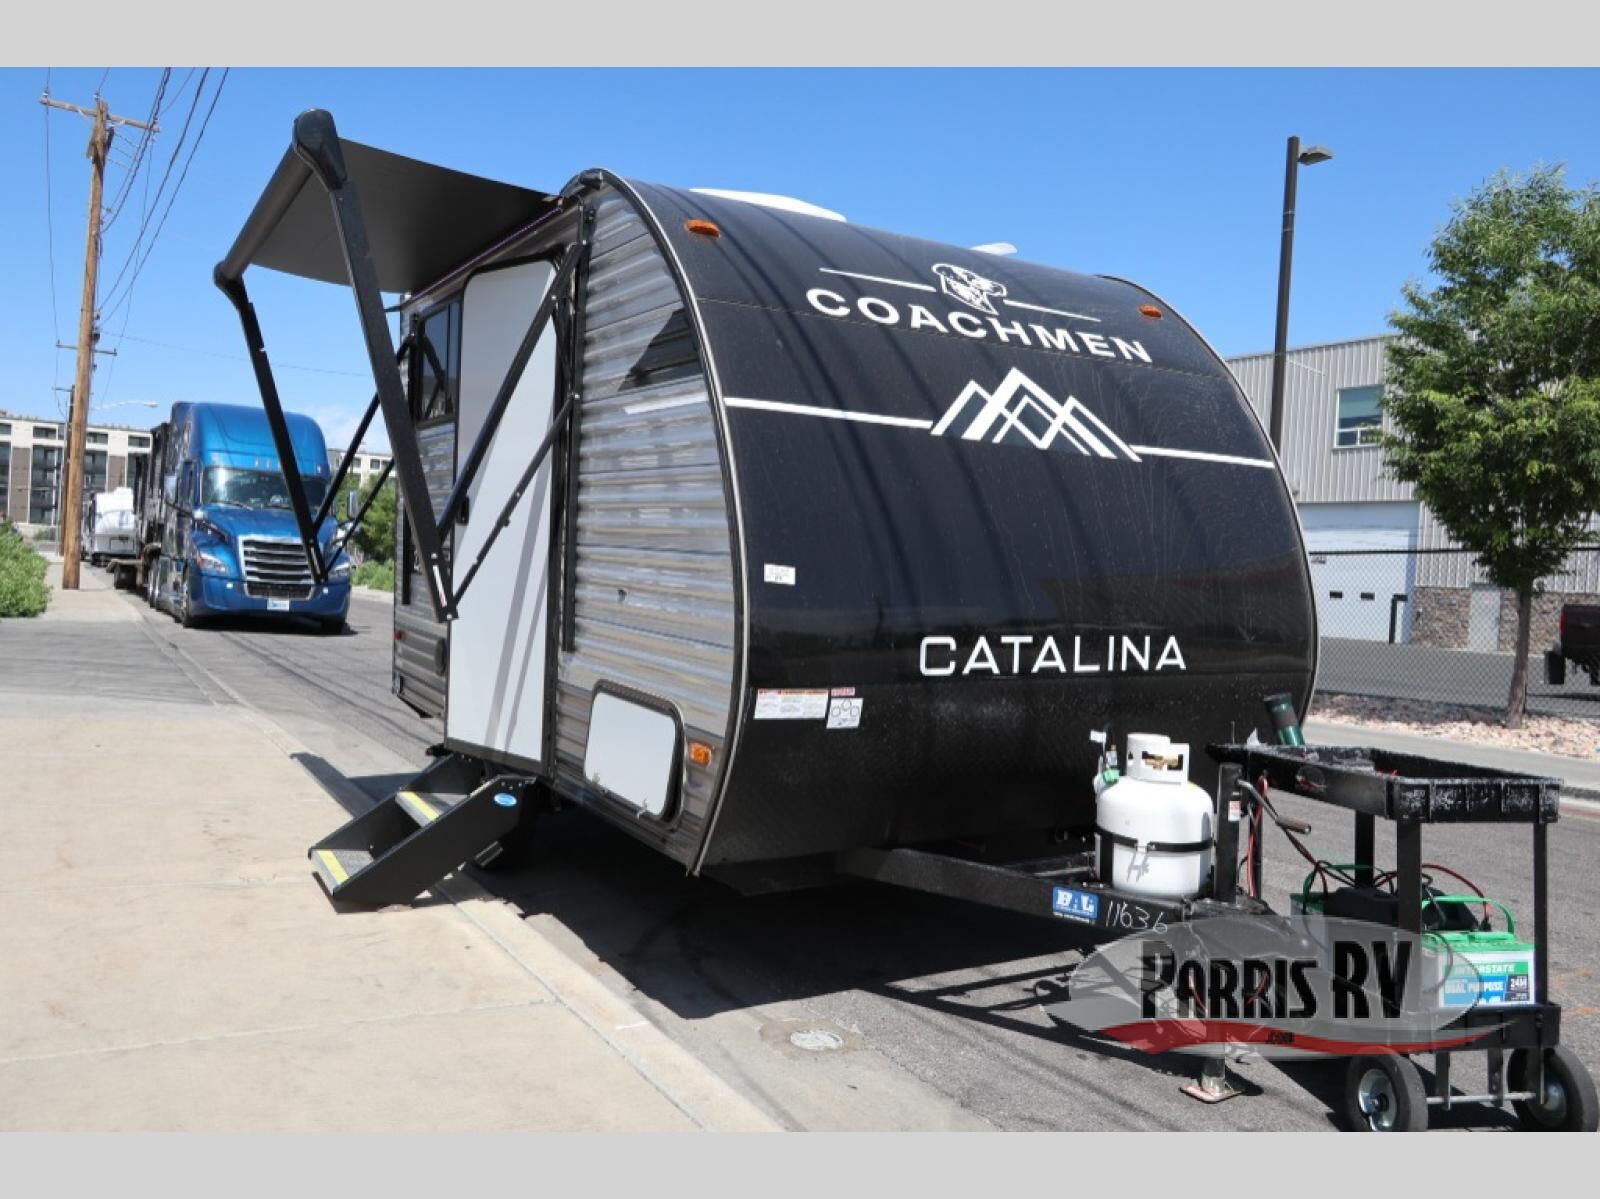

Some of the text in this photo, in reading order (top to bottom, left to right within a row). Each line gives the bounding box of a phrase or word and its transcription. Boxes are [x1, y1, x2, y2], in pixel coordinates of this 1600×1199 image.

[805, 288, 1153, 363] COACHMEN
[919, 635, 1186, 677] CATALINA
[1105, 901, 1169, 934] 11636
